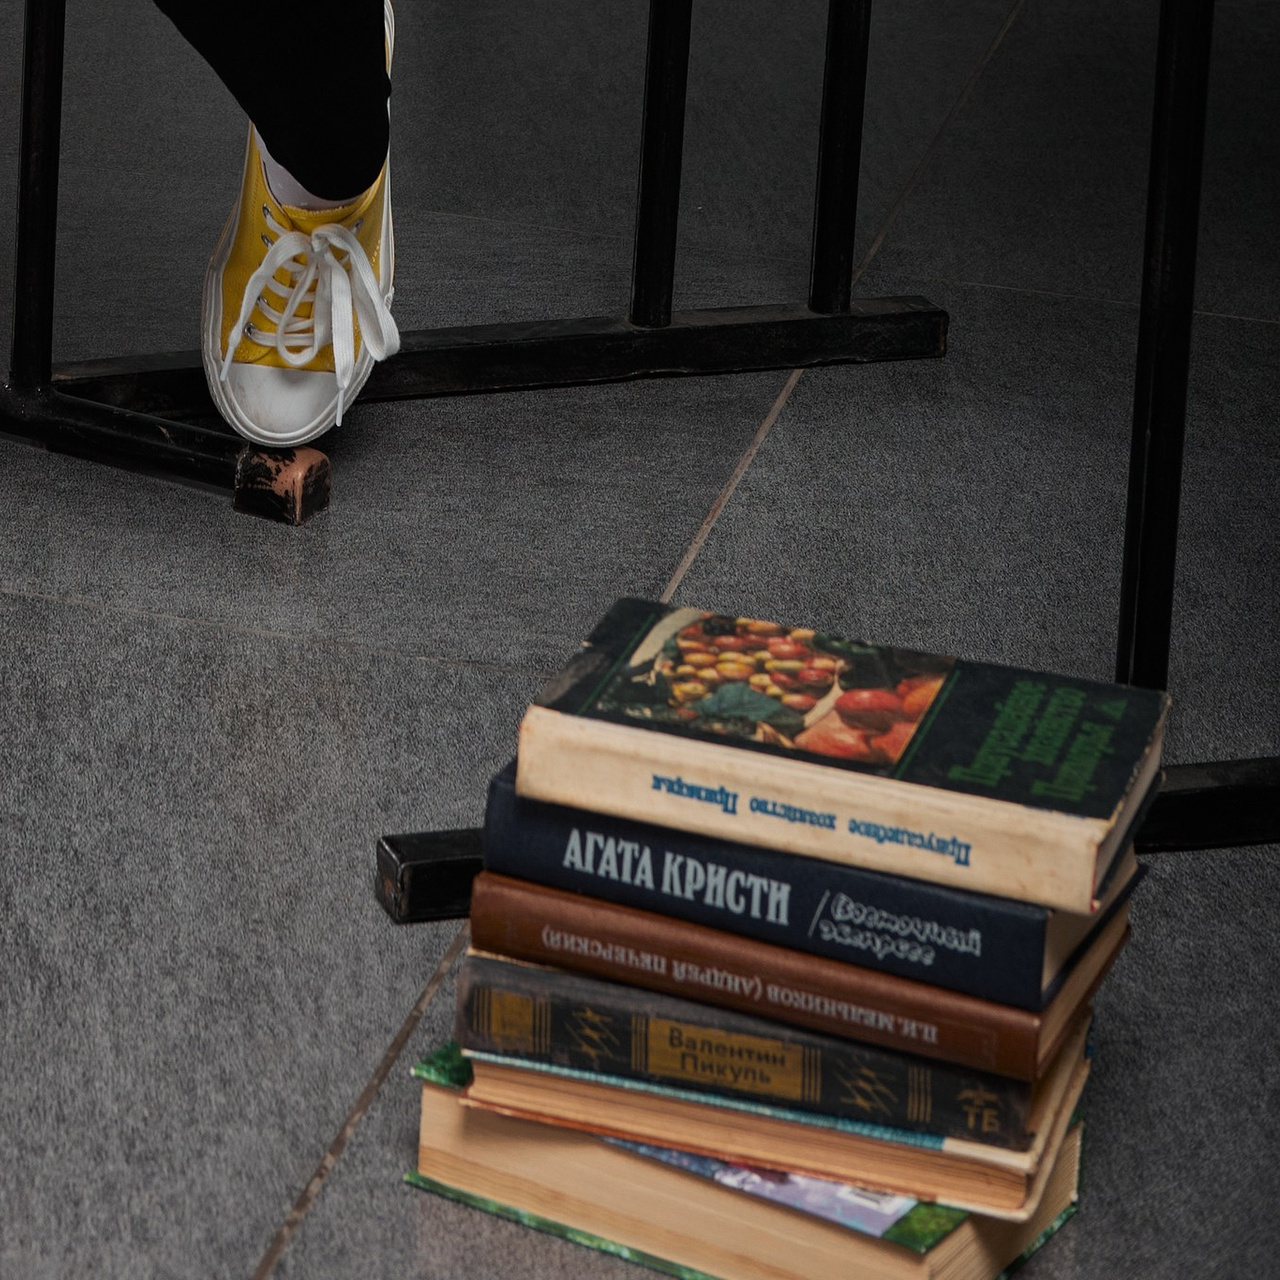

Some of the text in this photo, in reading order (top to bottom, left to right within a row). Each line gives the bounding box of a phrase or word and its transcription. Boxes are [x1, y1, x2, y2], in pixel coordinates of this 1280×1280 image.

[562, 829, 791, 927] АГАТА КРИСТИ
[765, 983, 896, 1033] МЕЛЬНИКОВ
[667, 1028, 788, 1069] Валентин
[679, 1053, 773, 1087] Пикуль
